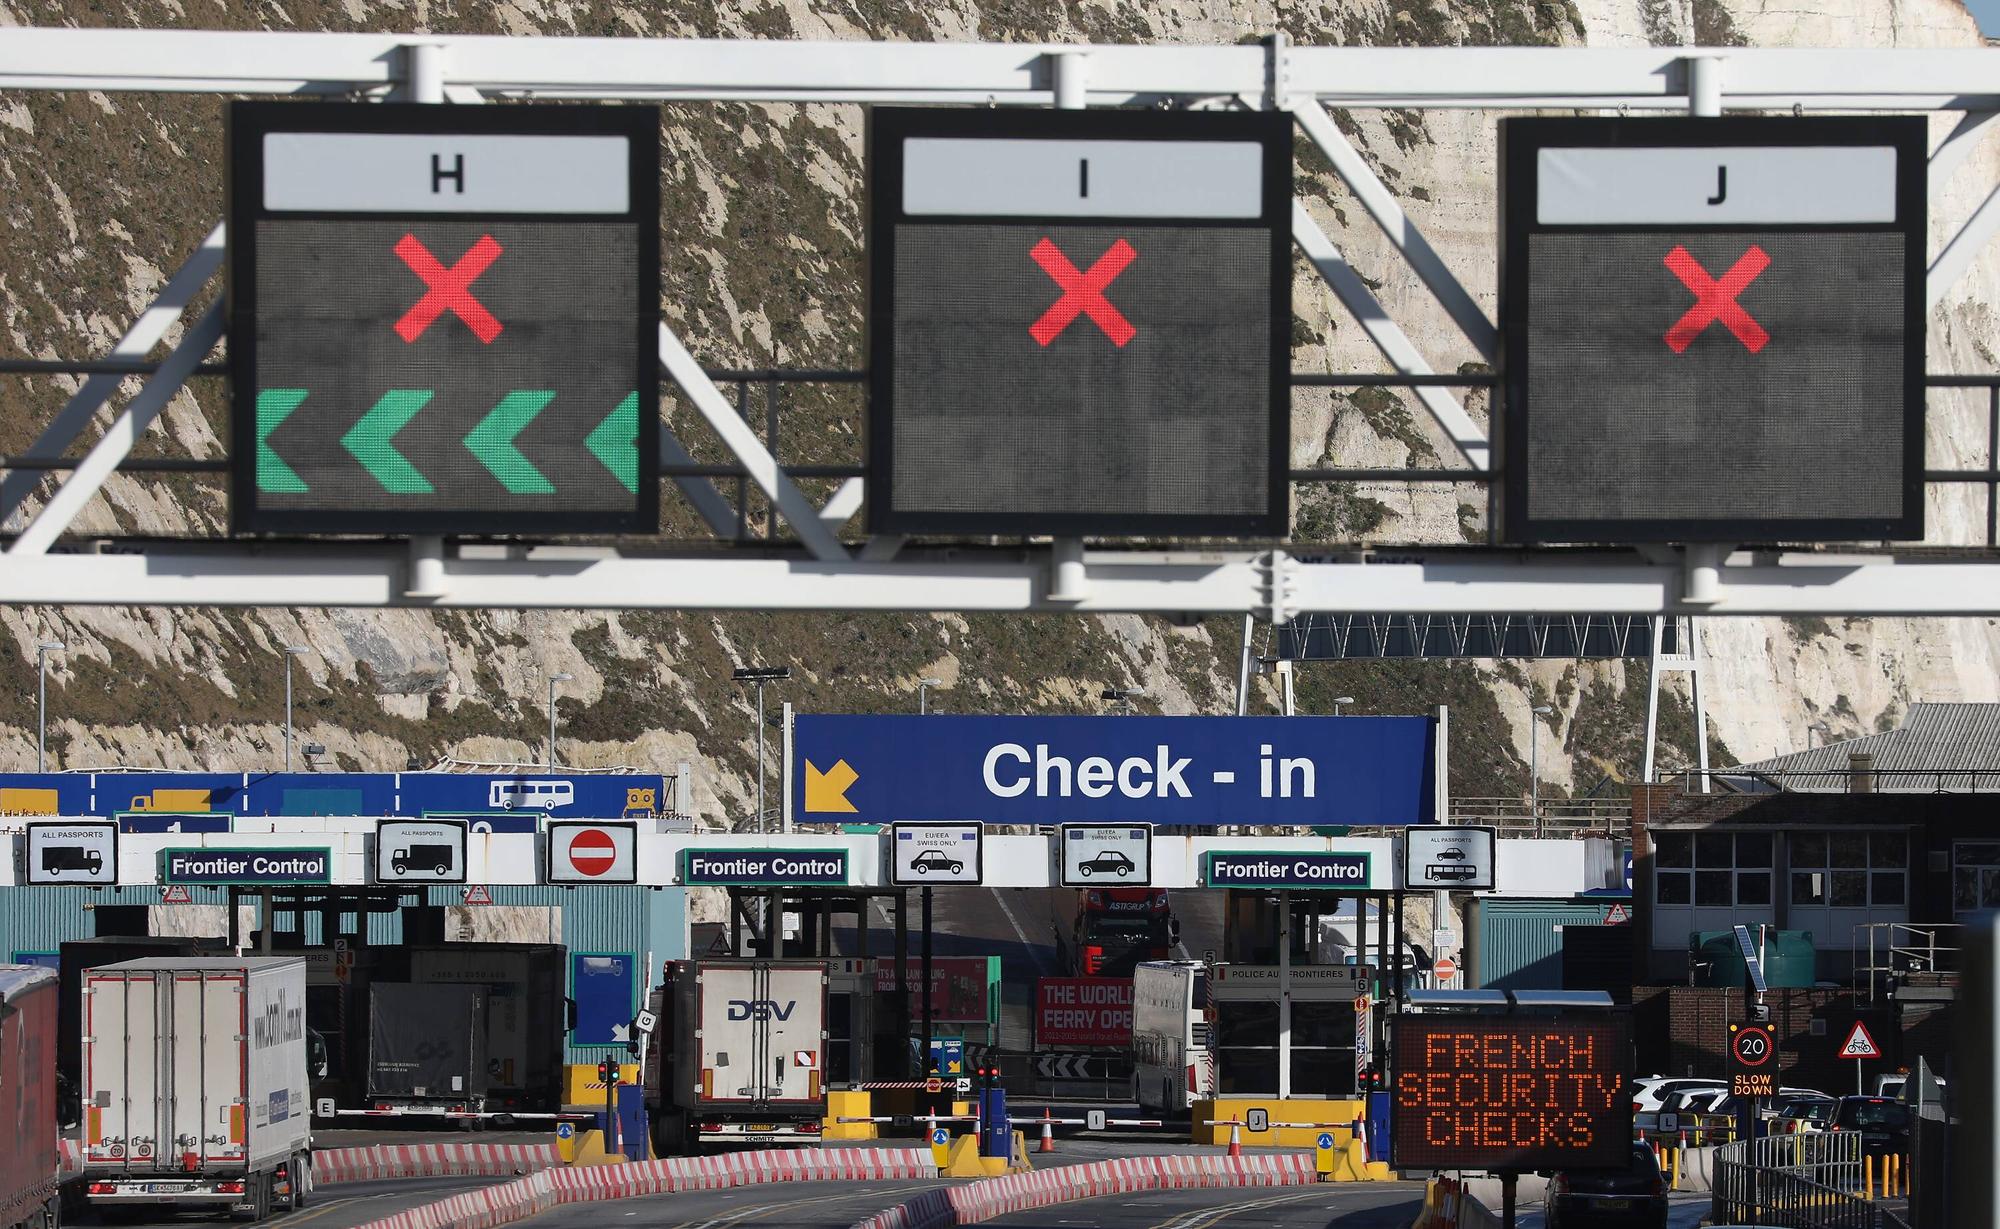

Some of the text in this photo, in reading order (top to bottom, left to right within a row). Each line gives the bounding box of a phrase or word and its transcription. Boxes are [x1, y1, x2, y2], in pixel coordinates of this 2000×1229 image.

[431, 155, 465, 194] H
[1079, 158, 1088, 198] I
[1707, 164, 1727, 207] J
[982, 743, 1192, 799] Check
[1260, 743, 1316, 798] in
[41, 831, 104, 839] ALL PASSPORTS
[172, 857, 324, 876] Frontier Control
[692, 858, 841, 876] Frontier Control
[1214, 860, 1364, 878] Frontier Control
[337, 941, 345, 950] 2
[1205, 952, 1213, 962] 5
[1357, 979, 1366, 990] 6
[1044, 986, 1076, 1004] THE
[727, 1000, 797, 1022] DSV
[1044, 1009, 1097, 1029] FERRY
[642, 1017, 652, 1026] G
[1425, 1033, 1594, 1070] FRENCH
[1742, 1038, 1765, 1055] 20
[1735, 1074, 1771, 1085] SLOW
[1398, 1073, 1622, 1108] SECURITY
[1734, 1085, 1772, 1095] DOWN
[322, 1103, 330, 1113] E
[1254, 1114, 1261, 1126] J
[1665, 1117, 1672, 1127] L
[1425, 1112, 1594, 1147] CHECKS
